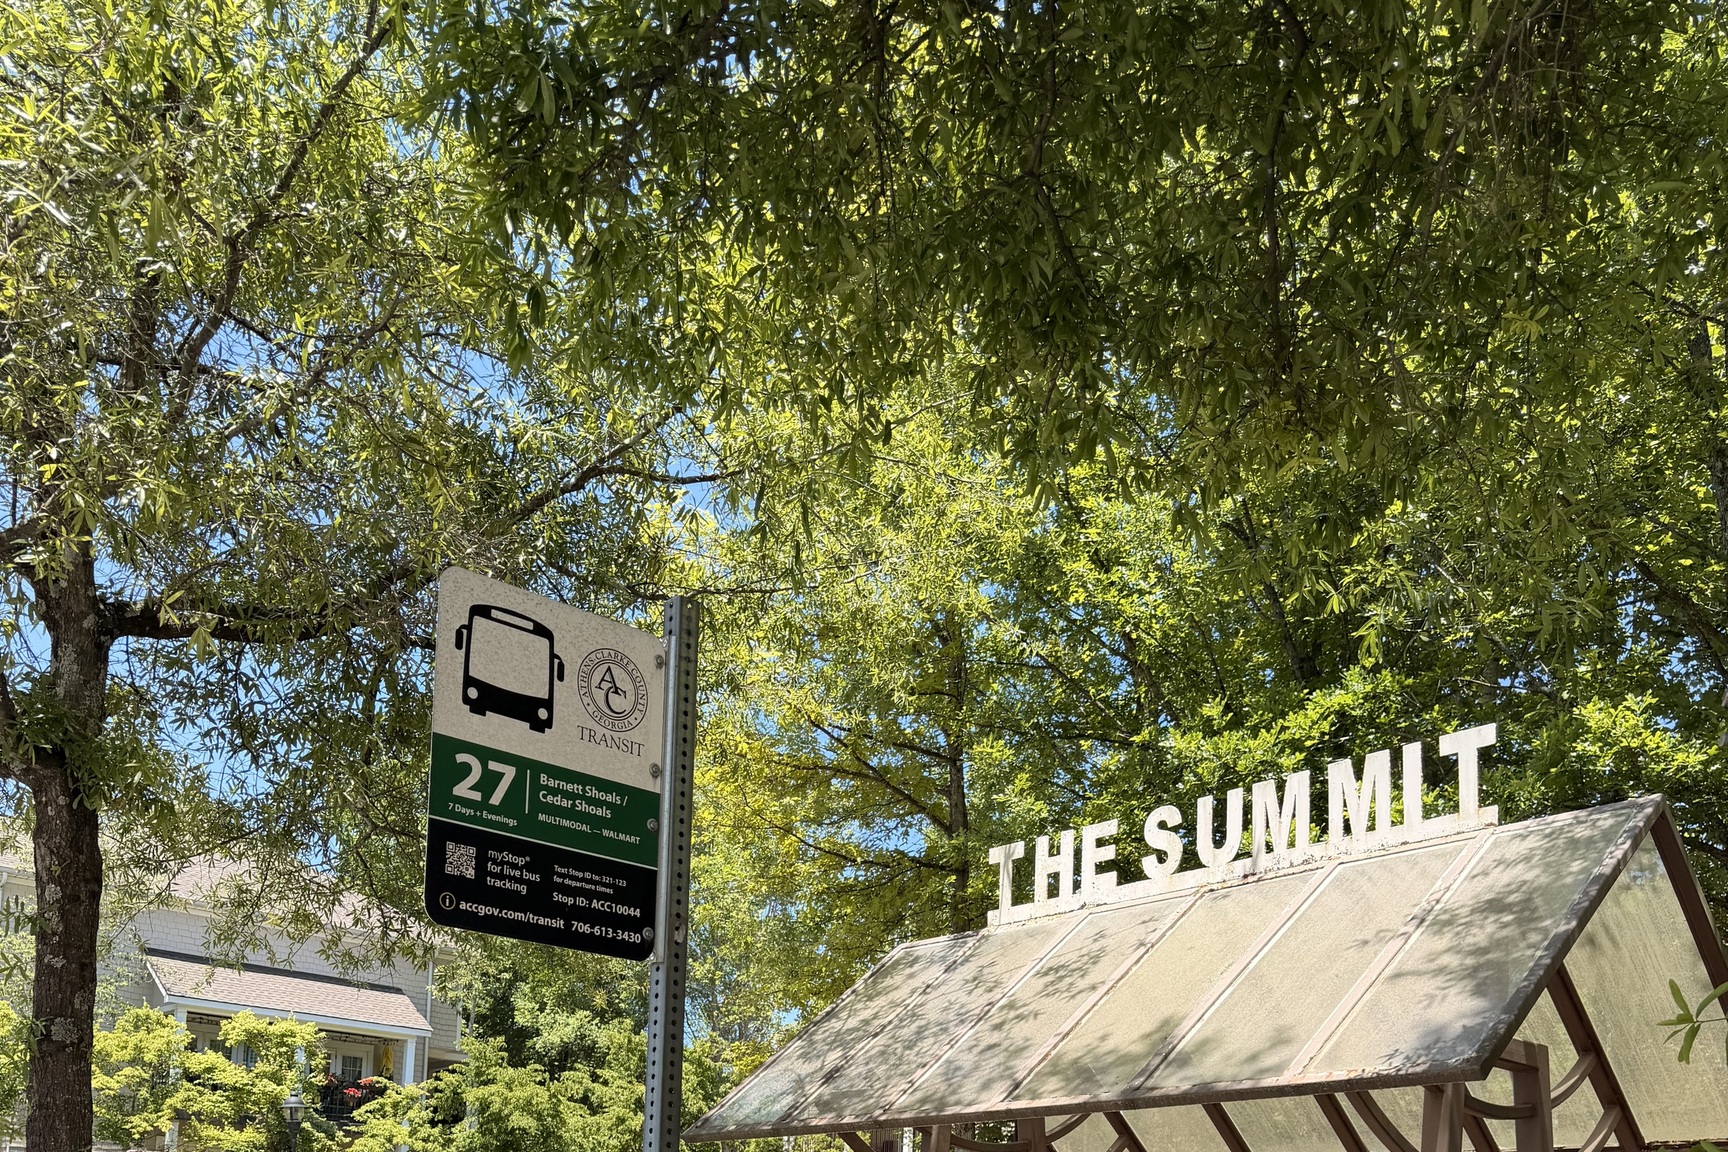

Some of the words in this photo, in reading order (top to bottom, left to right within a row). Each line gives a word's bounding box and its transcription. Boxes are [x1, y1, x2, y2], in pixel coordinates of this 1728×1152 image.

[631, 667, 645, 715] COUNTY
[592, 710, 633, 730] GEORGIA
[577, 725, 645, 757] TRANSIT
[452, 753, 516, 806] 27
[540, 773, 583, 795] Barnett
[585, 785, 621, 805] Shoals
[448, 802, 454, 810] 7
[455, 804, 474, 816] Days
[482, 810, 518, 827] Evenings
[539, 790, 573, 808] Cedar
[575, 799, 612, 818] Shoals
[989, 818, 1118, 912] THE
[1142, 723, 1497, 880] SUMMIT
[538, 812, 592, 833] MULTIMODAL
[602, 828, 640, 845] WALMART
[487, 861, 502, 873] for
[503, 865, 521, 878] live
[523, 869, 540, 882] bus
[487, 876, 527, 895] tracking
[553, 875, 563, 883] for
[564, 878, 596, 890] departure
[596, 885, 614, 894] times
[554, 864, 568, 874] Text
[568, 868, 584, 878] Stop
[602, 875, 627, 887] 321-123
[553, 892, 575, 906] Stop
[576, 897, 589, 908] ID:
[591, 899, 641, 918] ACC10044
[459, 899, 564, 929] accgov.com/transit
[571, 920, 641, 943] 706-613-3430
